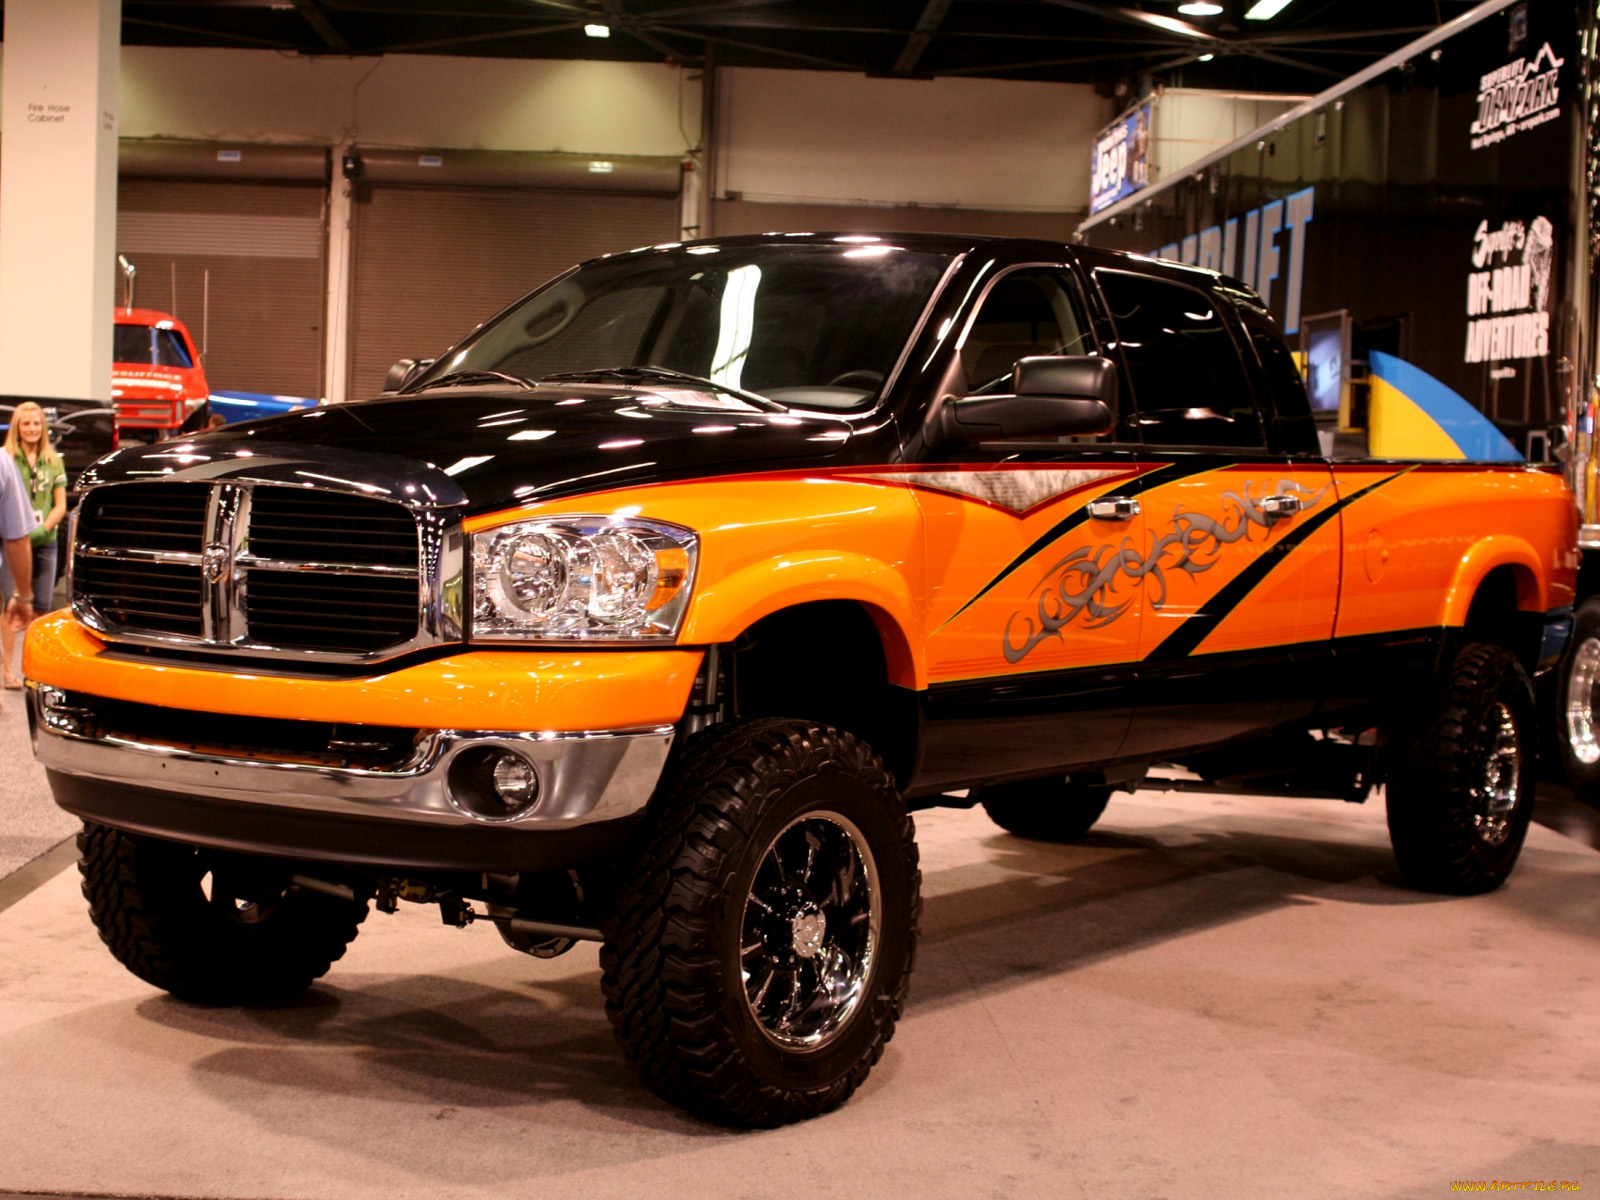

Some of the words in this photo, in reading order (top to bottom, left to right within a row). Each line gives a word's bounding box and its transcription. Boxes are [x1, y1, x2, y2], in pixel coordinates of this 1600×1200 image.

[27, 113, 65, 122] Cabinet
[28, 103, 44, 112] Fire
[48, 104, 71, 112] Hose
[1092, 141, 1128, 195] Jeep
[1467, 264, 1531, 316] OFF-ROAD
[1464, 311, 1550, 363] ADVENTURES
